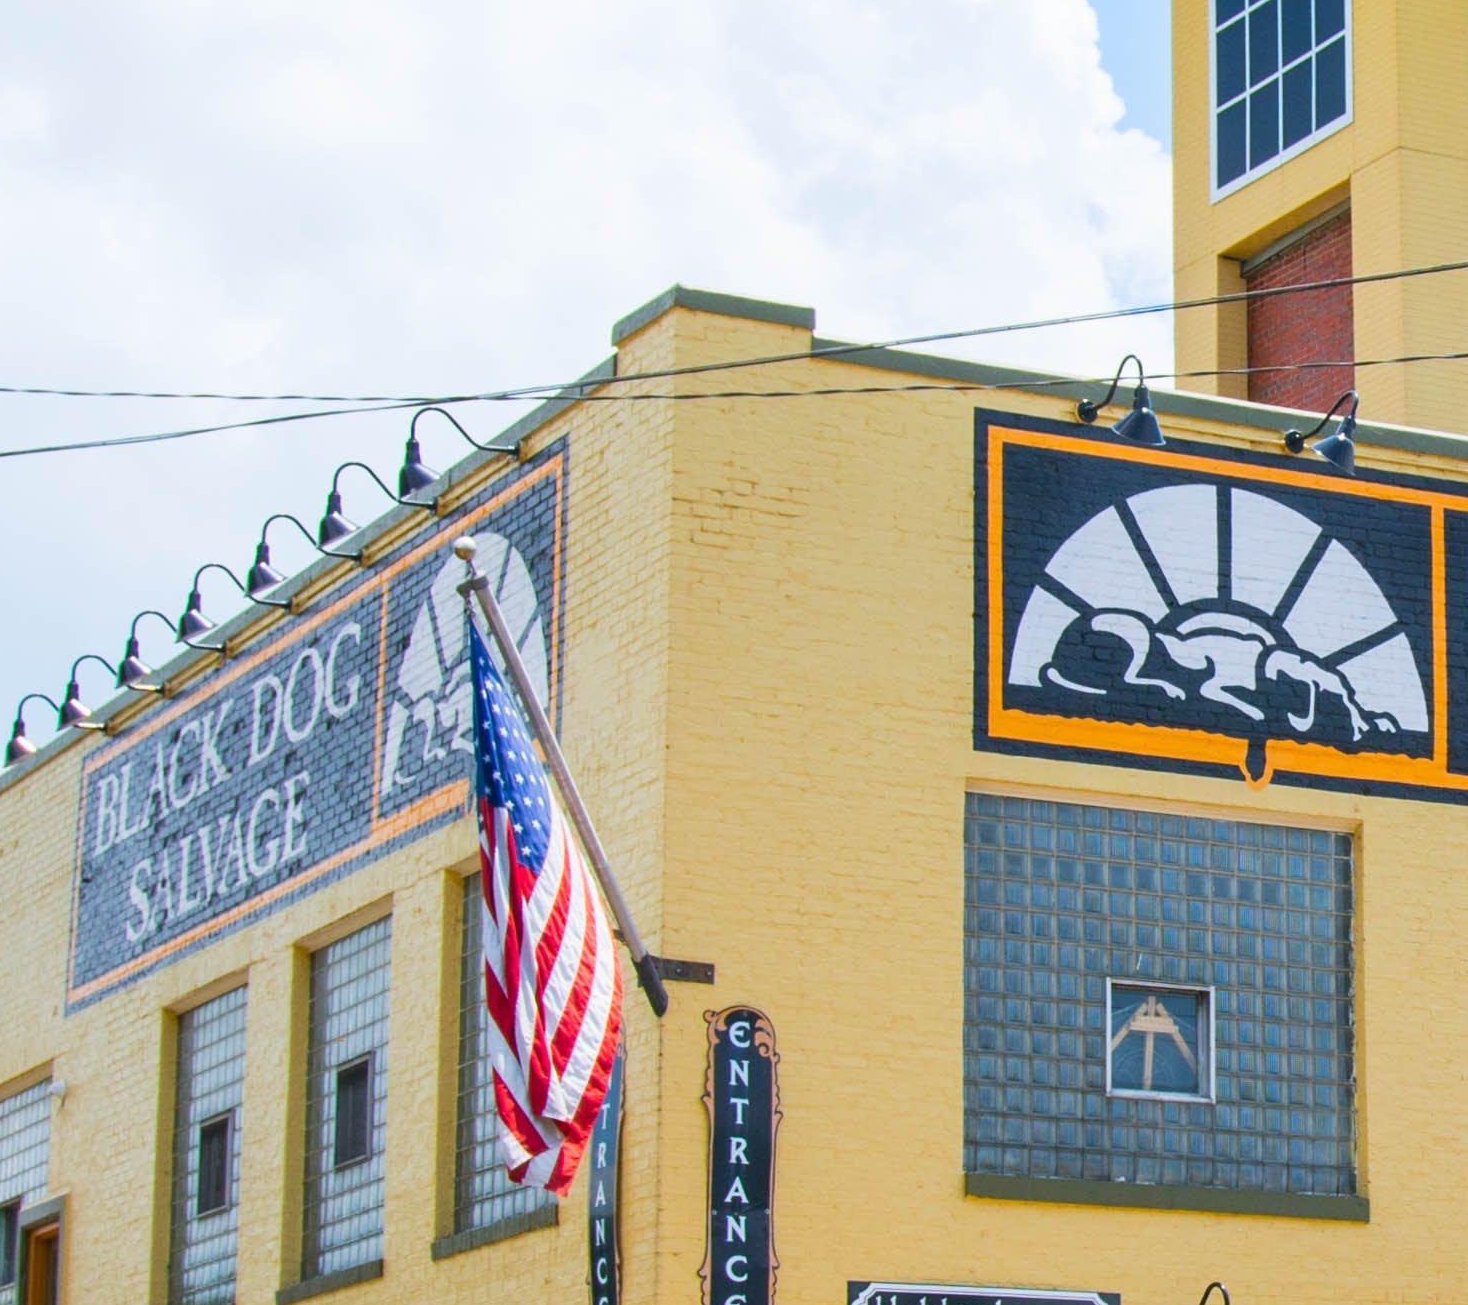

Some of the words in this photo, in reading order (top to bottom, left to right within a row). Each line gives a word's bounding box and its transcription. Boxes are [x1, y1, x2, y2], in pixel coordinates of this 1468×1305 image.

[91, 712, 229, 859] BLACK
[247, 623, 361, 766] DOG
[125, 771, 312, 942] SALVAGE
